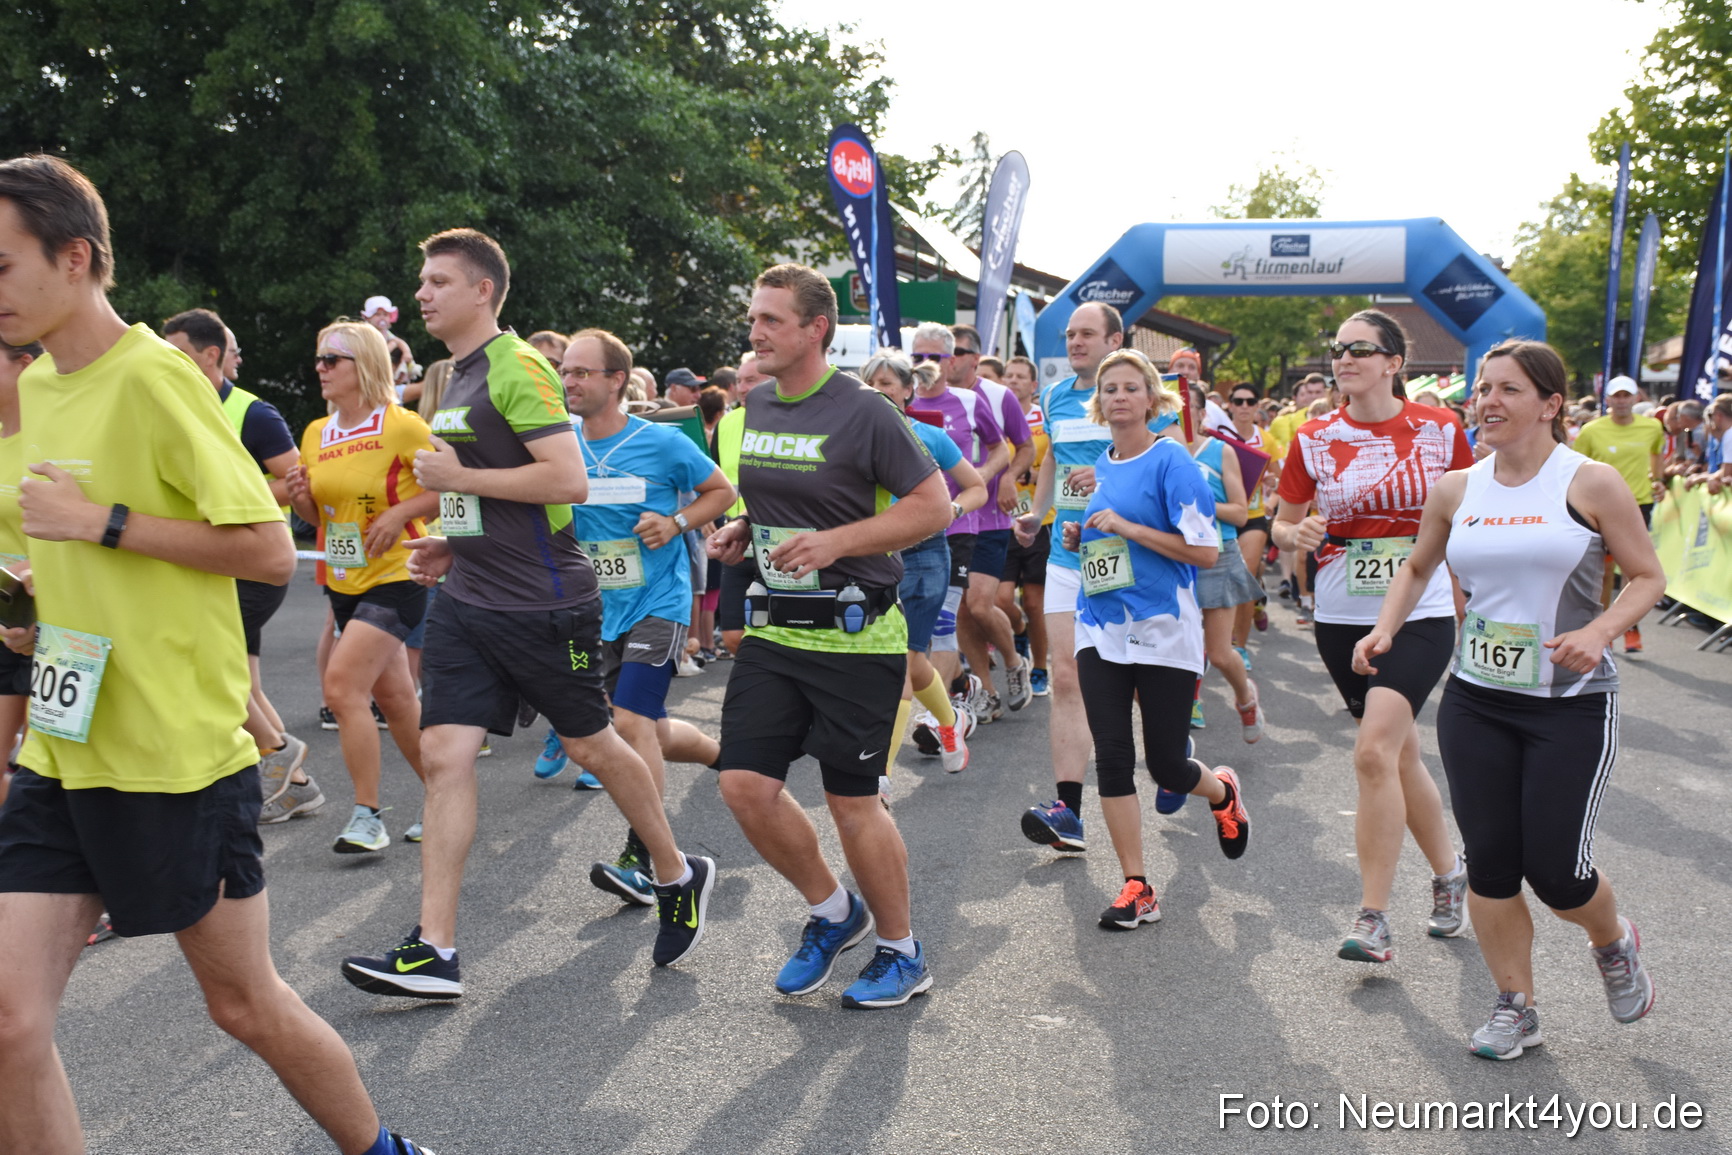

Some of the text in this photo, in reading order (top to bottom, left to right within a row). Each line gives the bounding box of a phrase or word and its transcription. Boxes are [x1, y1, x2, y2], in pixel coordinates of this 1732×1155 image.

[1254, 257, 1344, 275] firmenlauf
[1086, 281, 1135, 300] Fischer
[431, 410, 467, 431] OCK
[318, 440, 384, 463] MAX BÖGL
[741, 431, 822, 458] BOCK
[762, 459, 782, 469] smart
[782, 463, 817, 473] concepts
[443, 497, 465, 518] 306
[1483, 516, 1549, 526] KLEBL
[592, 557, 627, 576] 838
[1083, 555, 1120, 581] 1087
[1469, 637, 1526, 669] 1167
[1473, 661, 1516, 677] Mederer Birgit
